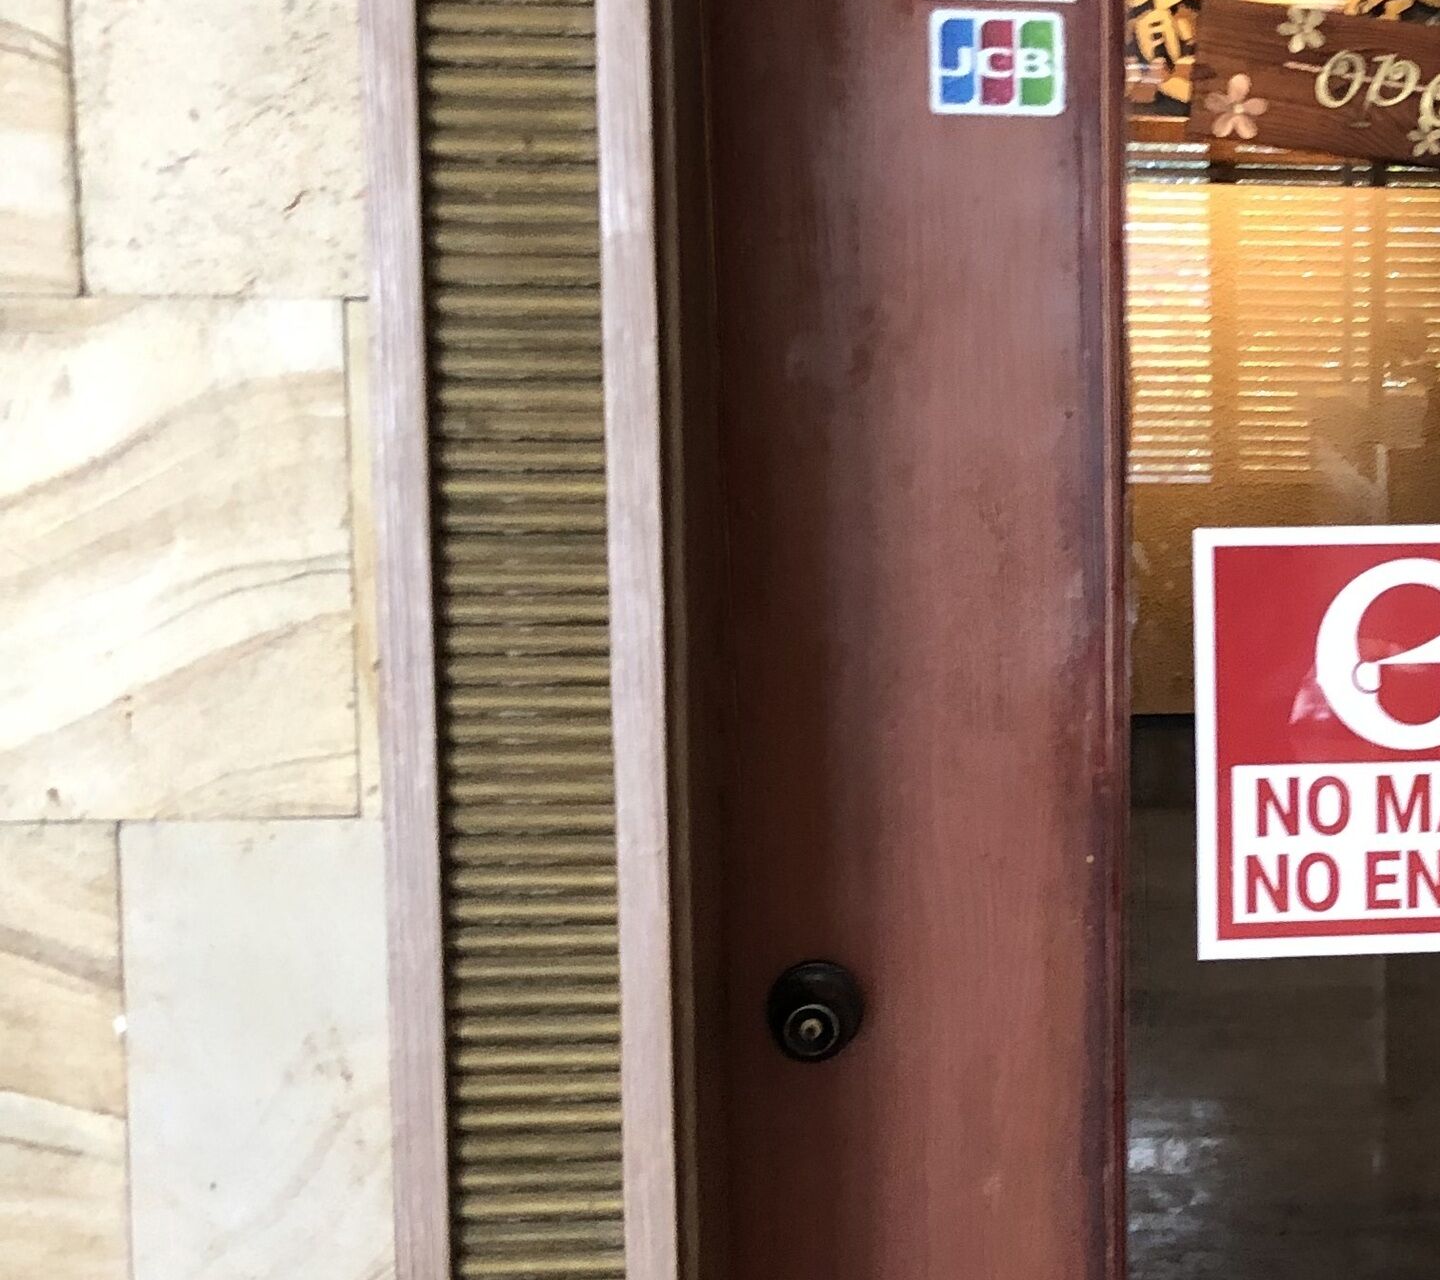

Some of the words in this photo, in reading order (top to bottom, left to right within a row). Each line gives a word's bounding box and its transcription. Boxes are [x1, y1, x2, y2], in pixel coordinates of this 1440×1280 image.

[939, 46, 1053, 79] JCB
[1255, 775, 1351, 838] NO
[1244, 852, 1341, 914] NO
